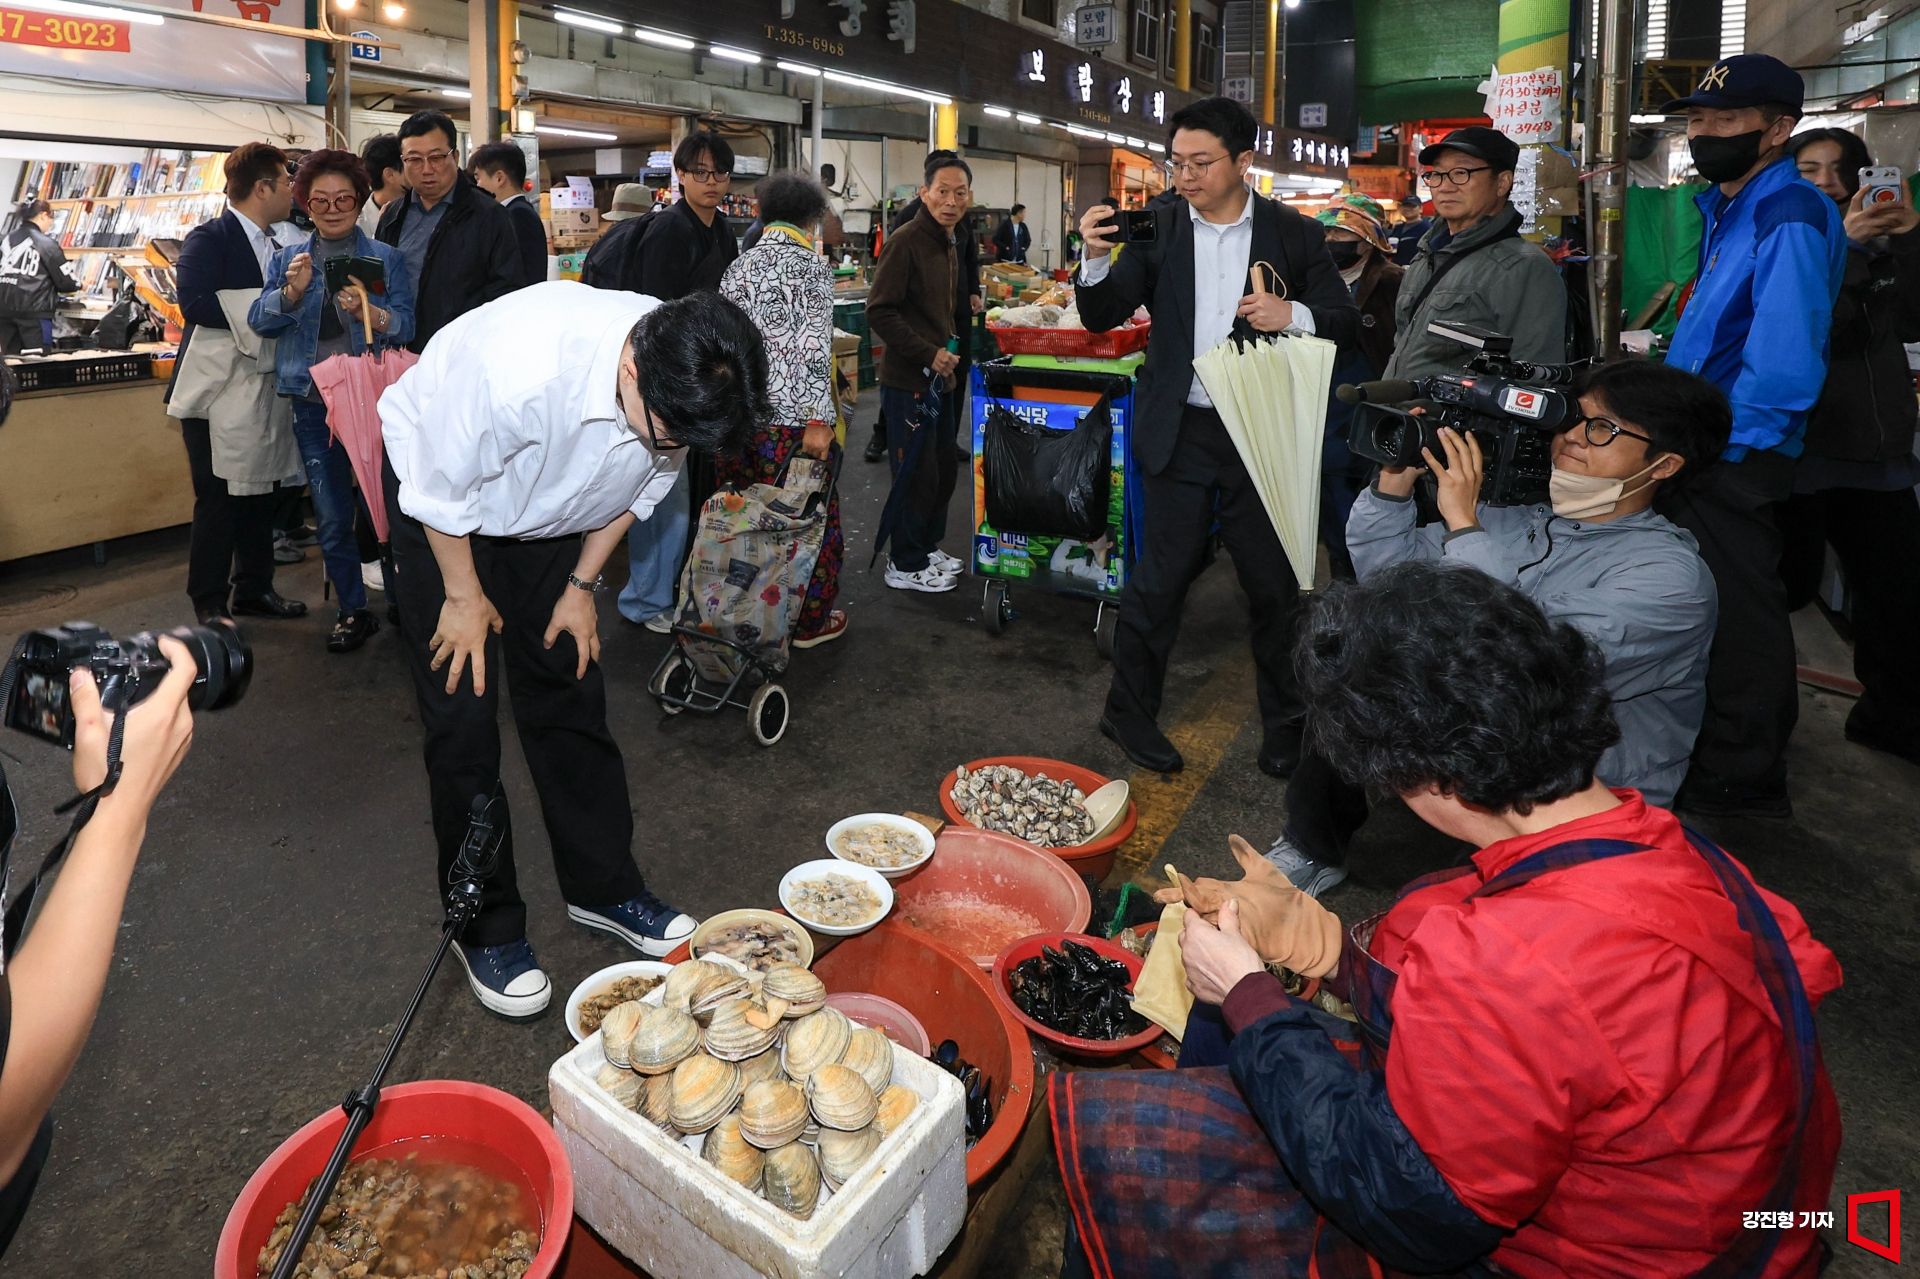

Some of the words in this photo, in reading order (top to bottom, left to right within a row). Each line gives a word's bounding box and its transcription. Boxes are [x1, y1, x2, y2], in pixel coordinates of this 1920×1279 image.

[1082, 10, 1106, 24] 보람
[1082, 25, 1106, 40] 상회
[764, 24, 845, 57] T.335-6968
[356, 44, 377, 58] 13
[1028, 48, 1166, 125] 보람상회
